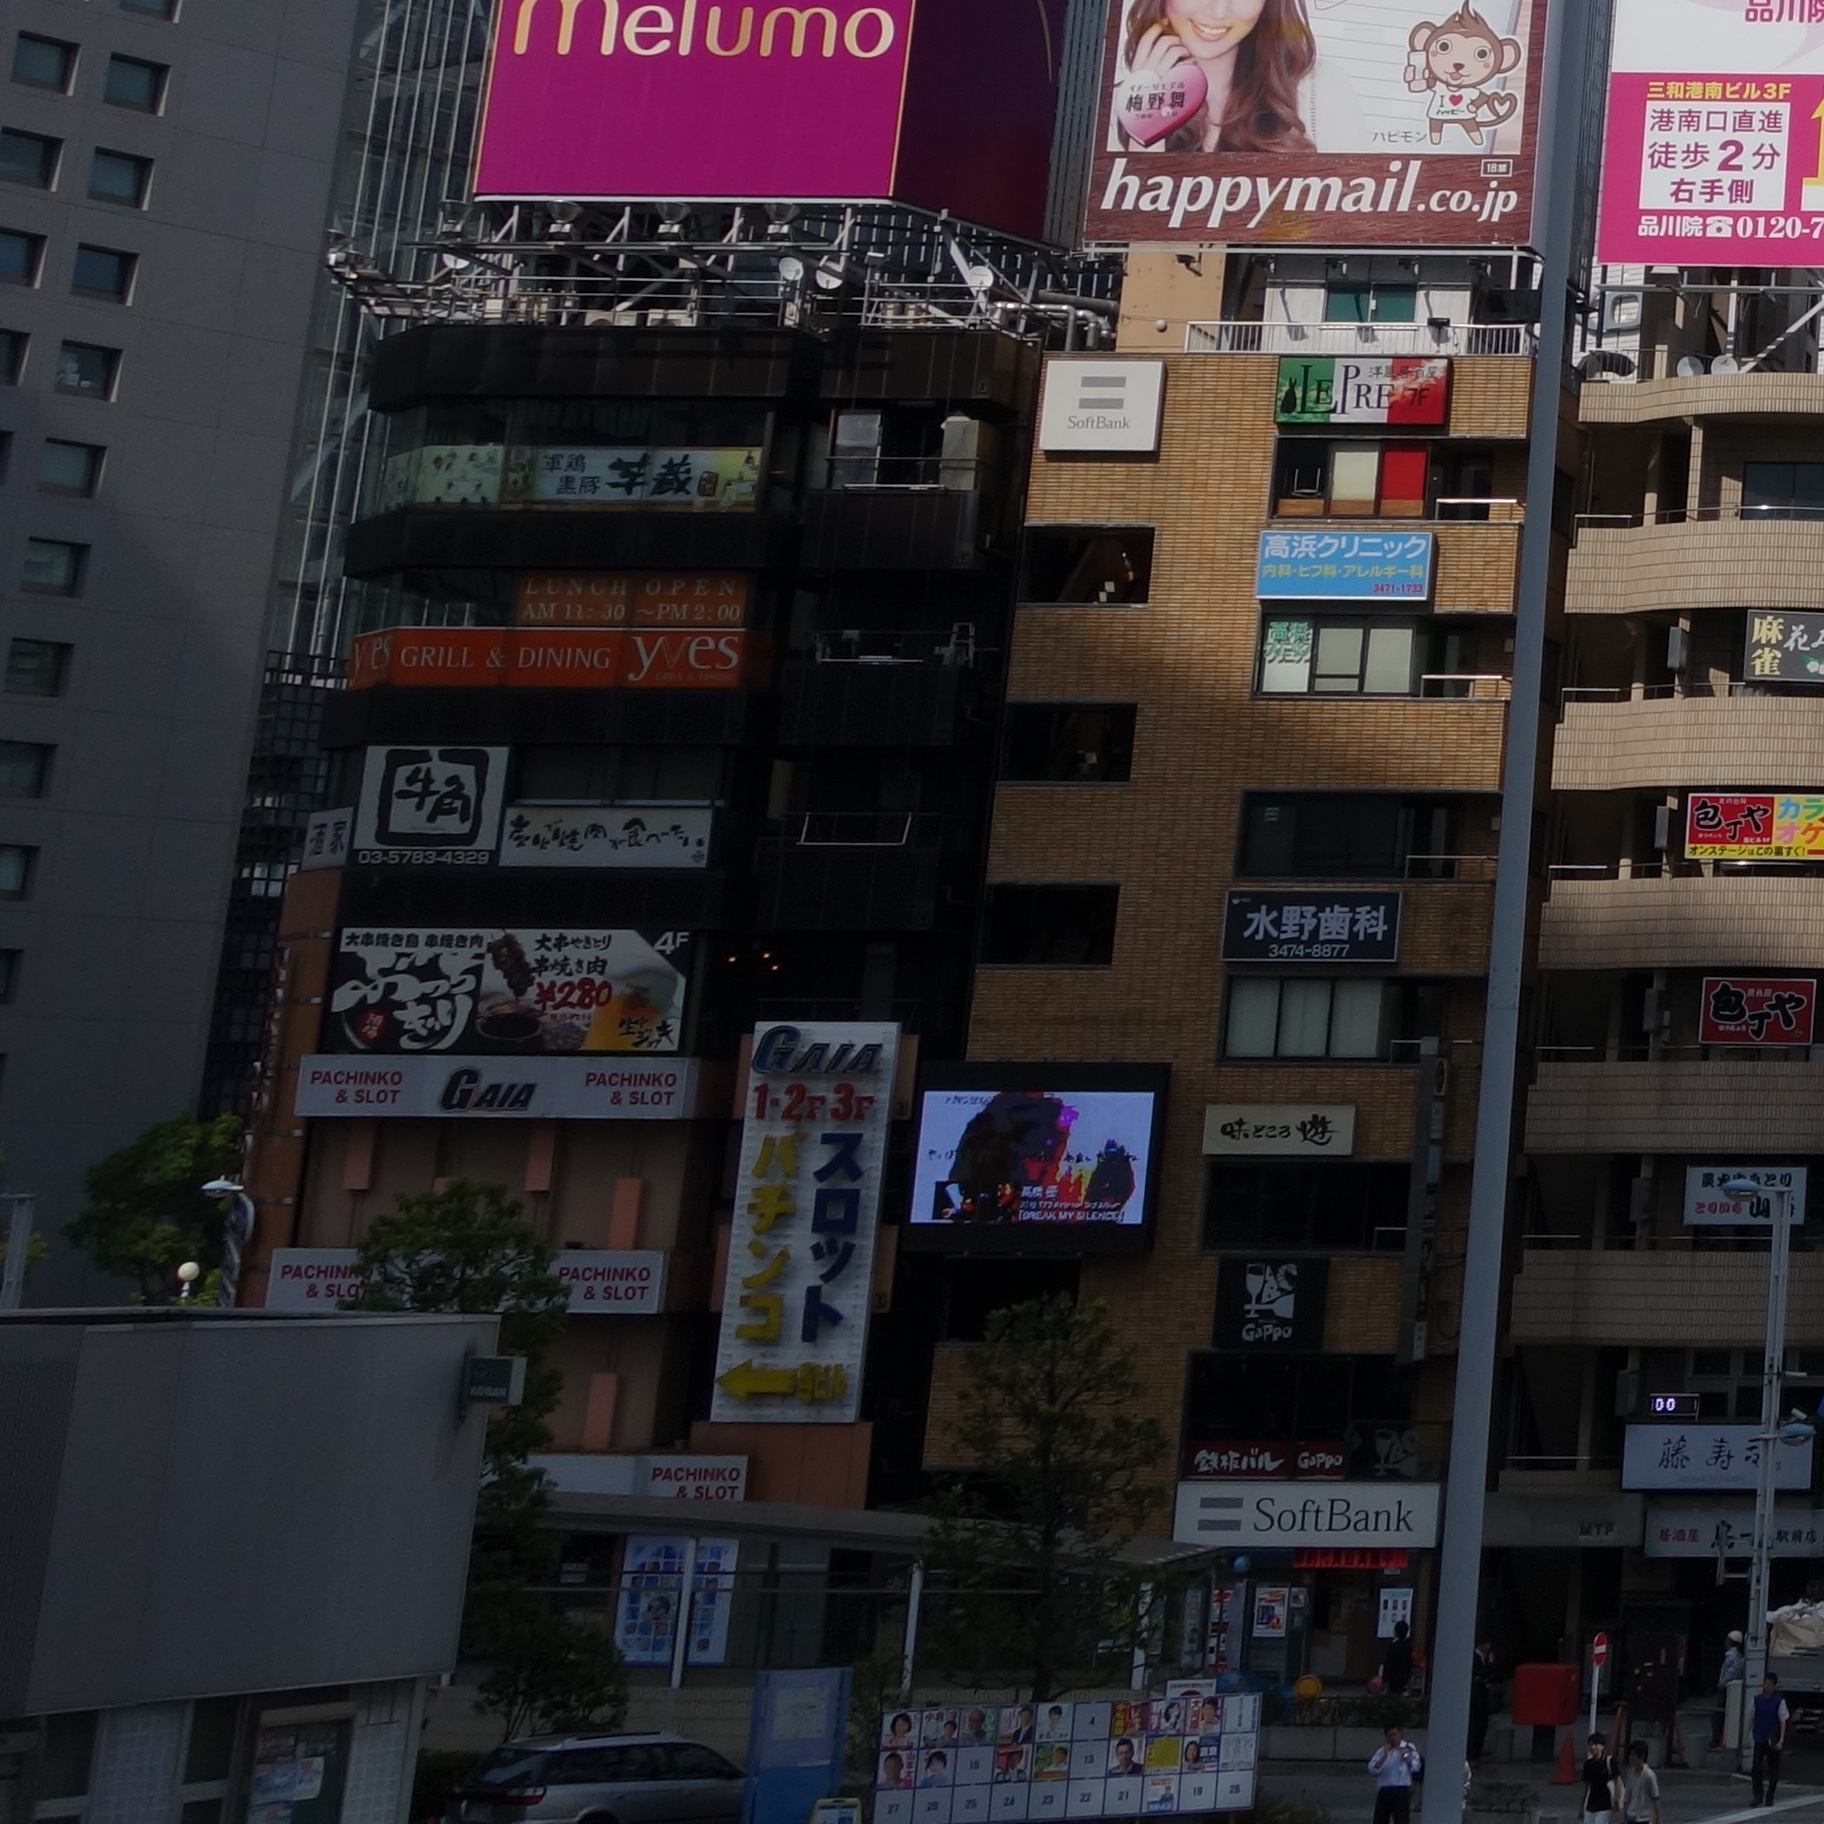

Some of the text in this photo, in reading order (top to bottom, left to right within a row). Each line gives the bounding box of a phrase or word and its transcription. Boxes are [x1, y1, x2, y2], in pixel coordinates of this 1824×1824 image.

[1125, 90, 1186, 110] 梅野舞
[1647, 82, 1792, 100] 三和港南ビル3F
[1650, 109, 1783, 134] 港南口直進
[1647, 140, 1781, 171] 徒歩2分
[1101, 158, 1518, 228] happymail.co.jp
[1670, 179, 1755, 205] 右手側
[1638, 215, 1703, 239] 品川院
[1409, 389, 1430, 406] 7F
[1067, 415, 1131, 430] SoftBank
[1264, 535, 1427, 559] 高浜クリニック
[525, 580, 737, 596] LUNCH OPEN
[1751, 616, 1785, 676] 麻雀
[400, 646, 474, 669] GRILL
[517, 648, 611, 669] DINING
[395, 767, 471, 824] 牛角
[1694, 798, 1771, 842] 包丁や
[359, 850, 489, 865] 03-5783-4329
[1243, 905, 1388, 941] 水野歯科
[346, 933, 483, 949] 大串焼き鳥 串焼き肉
[536, 933, 612, 953] 大串やきとり
[654, 931, 689, 956] 4F
[1269, 944, 1350, 958] 3474-8877
[532, 956, 606, 976] 串焼き肉
[536, 979, 611, 1011] ¥280
[1711, 981, 1805, 1040] 包丁や
[753, 1025, 882, 1074] GAIA
[311, 1071, 403, 1086] PACHINKO
[586, 1072, 677, 1087] PACHINKO
[335, 1090, 400, 1104] & SLOT
[440, 1067, 538, 1113] GAIA
[611, 1091, 675, 1105] & SLOT
[736, 1128, 808, 1341] パチンコ
[802, 1132, 864, 1343] スロット
[559, 1267, 650, 1283] PACHINKO
[306, 1284, 319, 1298] &
[584, 1286, 649, 1301] & SLOT
[652, 1467, 741, 1482] PACHINKO
[676, 1486, 739, 1500] & SLOT
[1254, 1497, 1414, 1533] SoftBank
[1658, 1528, 1699, 1543] 居酒屋
